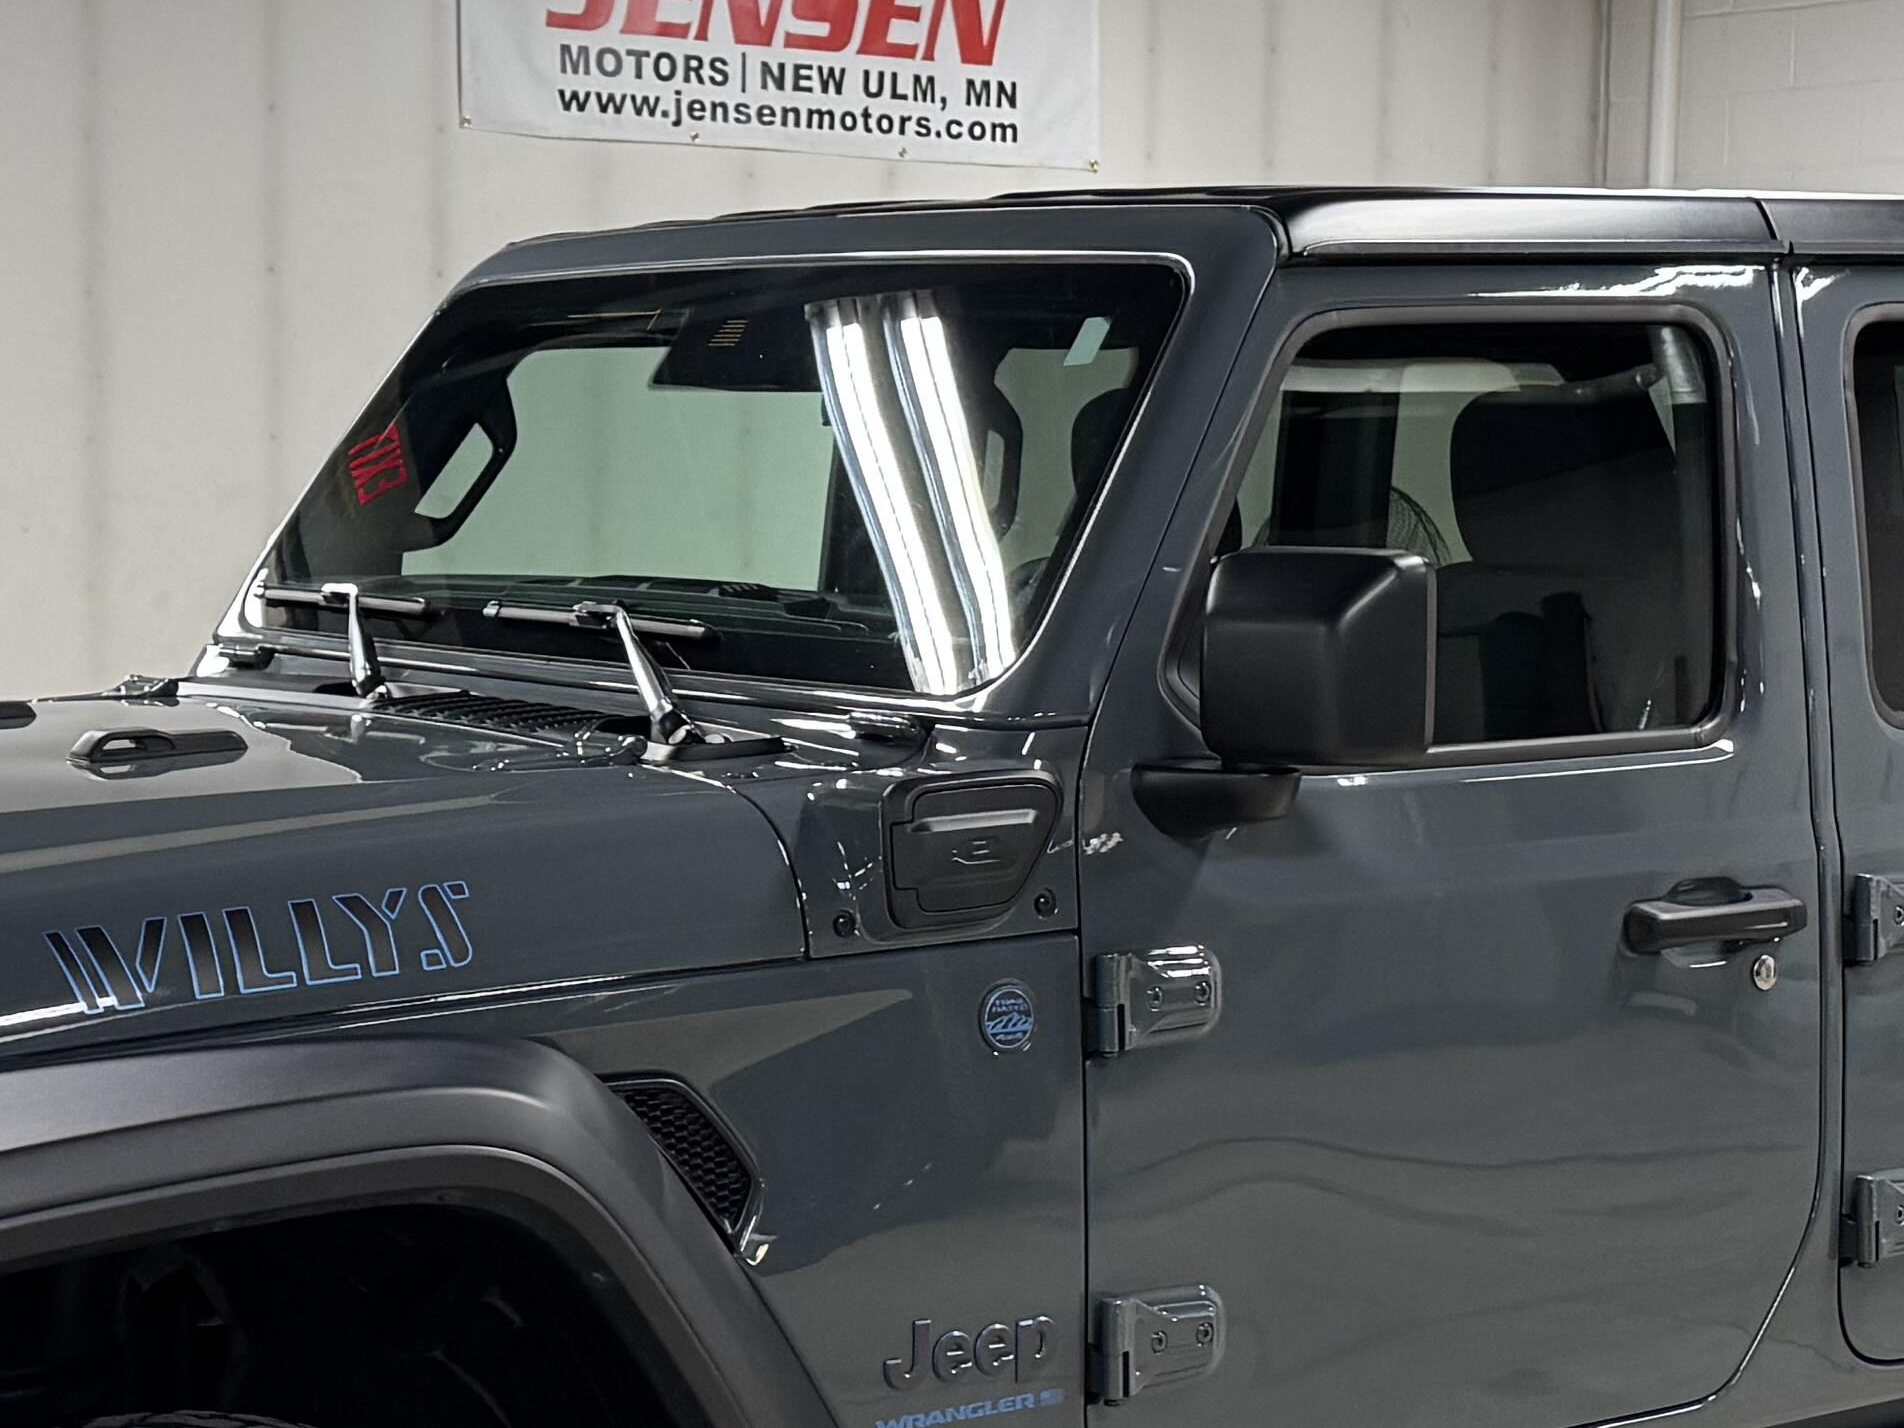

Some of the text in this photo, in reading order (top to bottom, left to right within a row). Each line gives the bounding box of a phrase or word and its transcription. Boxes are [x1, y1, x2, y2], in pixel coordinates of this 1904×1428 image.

[559, 43, 1018, 112] MOTORS NEW ULM, MN
[558, 85, 1019, 143] www.jensenmotors.com
[43, 881, 473, 1014] WILLYS
[883, 1316, 1055, 1390] Jeep
